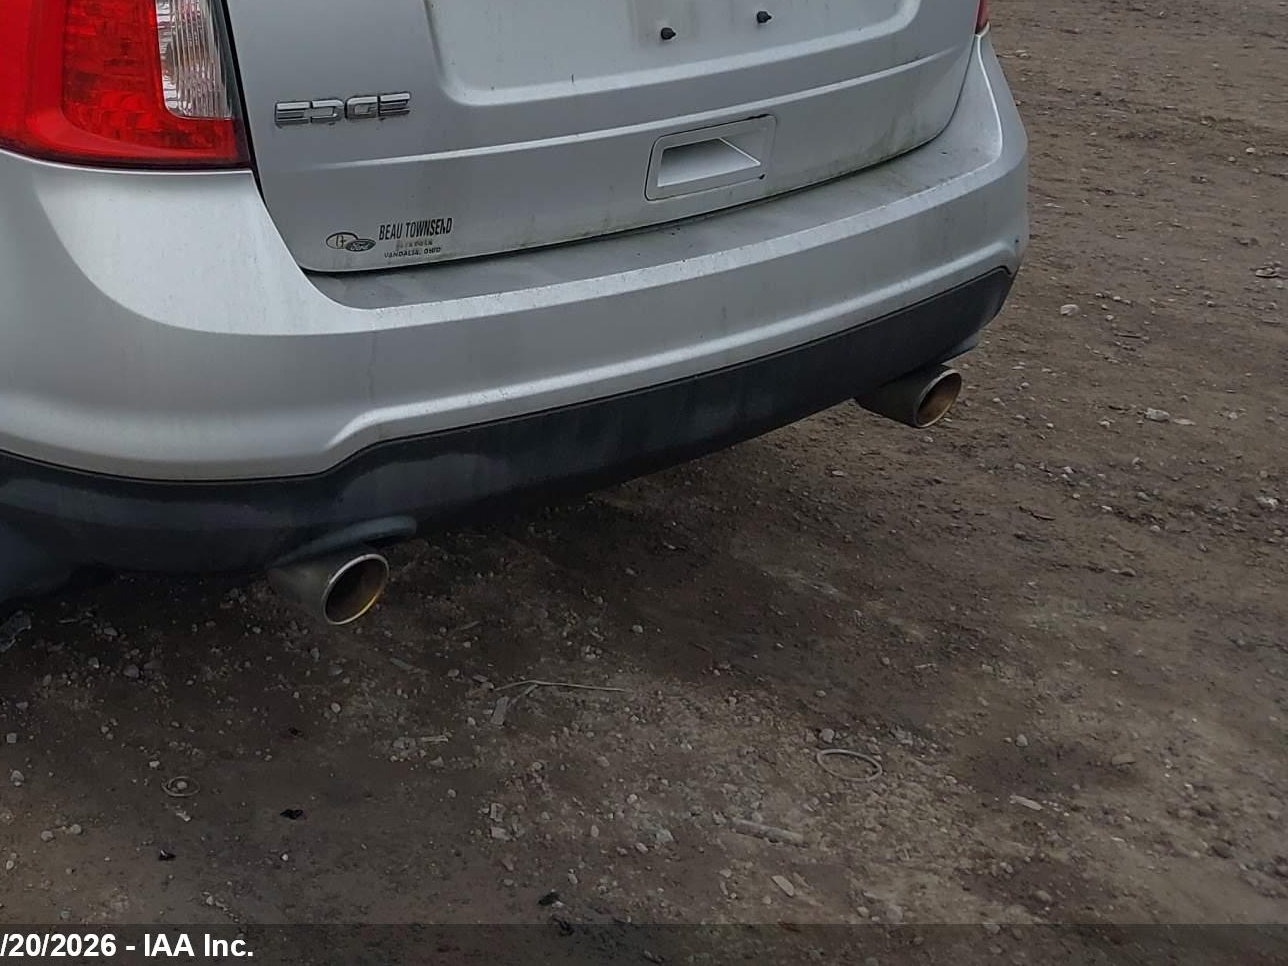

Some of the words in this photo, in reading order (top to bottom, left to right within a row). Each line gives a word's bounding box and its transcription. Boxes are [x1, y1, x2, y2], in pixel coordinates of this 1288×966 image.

[275, 92, 411, 126] EDGE
[378, 223, 404, 241] BEAU
[405, 217, 453, 238] TOWNSEND
